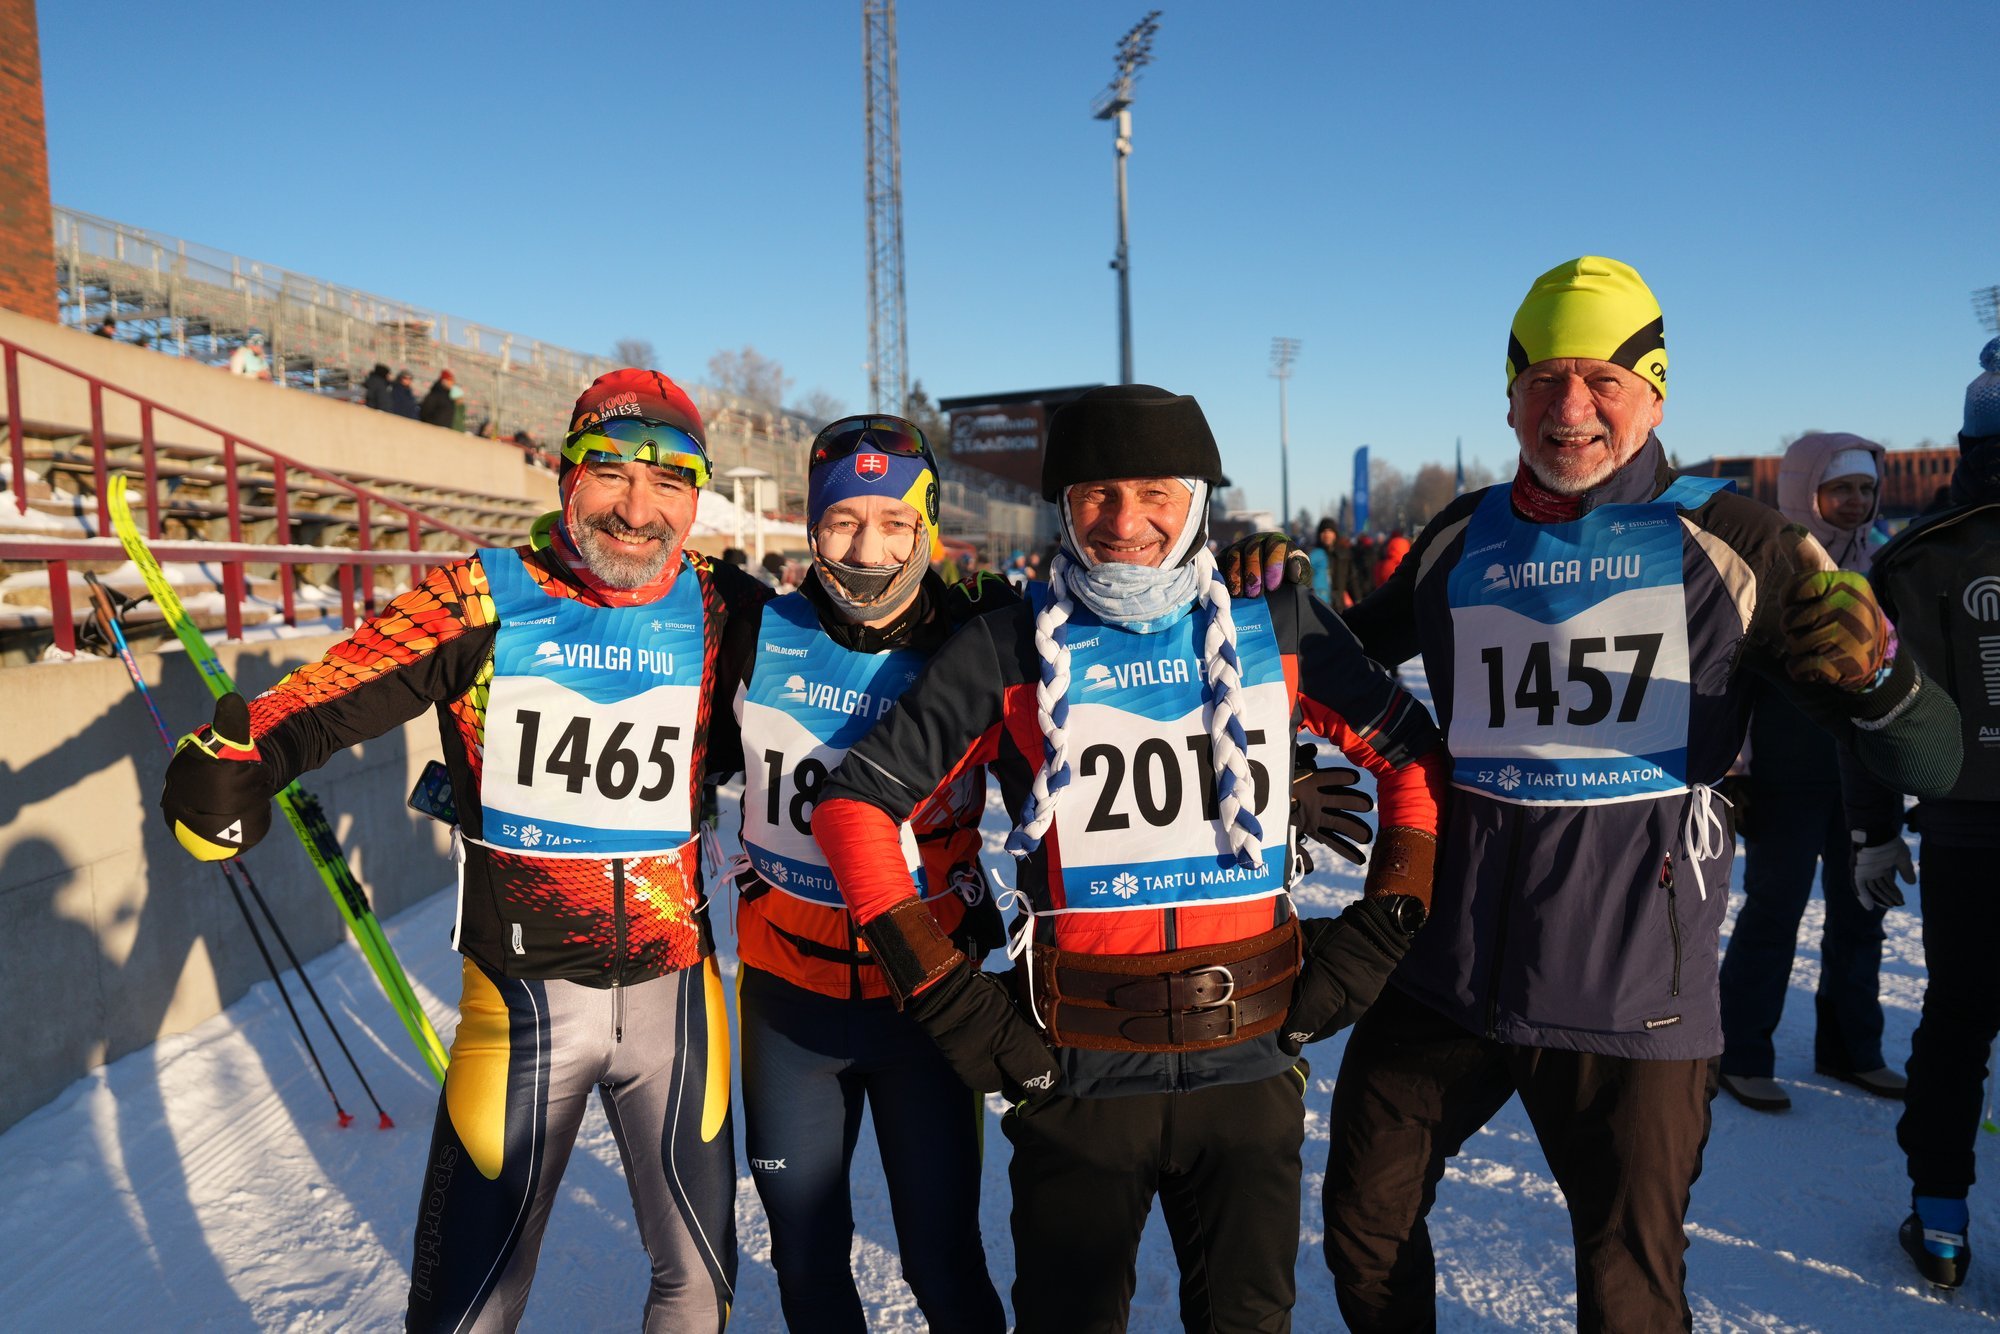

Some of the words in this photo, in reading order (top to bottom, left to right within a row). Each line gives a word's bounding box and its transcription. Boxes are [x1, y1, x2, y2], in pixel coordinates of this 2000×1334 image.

[1509, 560, 1580, 588] VALGA
[1591, 555, 1640, 581] PUU
[665, 622, 696, 630] ESTOLOPPET
[765, 642, 808, 658] WORLDLOPPET
[1068, 637, 1099, 650] DLOPPET
[564, 643, 632, 671] VALGA
[638, 652, 674, 675] PUU
[1115, 659, 1189, 688] VALGA
[1481, 633, 1664, 728] 1457
[808, 682, 871, 717] VALGA
[1979, 726, 2000, 736] Au
[516, 709, 680, 802] 1465
[1477, 771, 1494, 783] 52
[1526, 772, 1577, 786] TARTU
[1582, 767, 1663, 786] MARATON
[764, 748, 829, 836] 18
[502, 824, 518, 838] 52
[760, 858, 770, 872] 52
[791, 871, 832, 891] TARTU
[1090, 881, 1108, 895] 52
[1143, 873, 1196, 890] TARTU
[751, 1158, 787, 1170] ATEX
[415, 1144, 458, 1301] sportful
